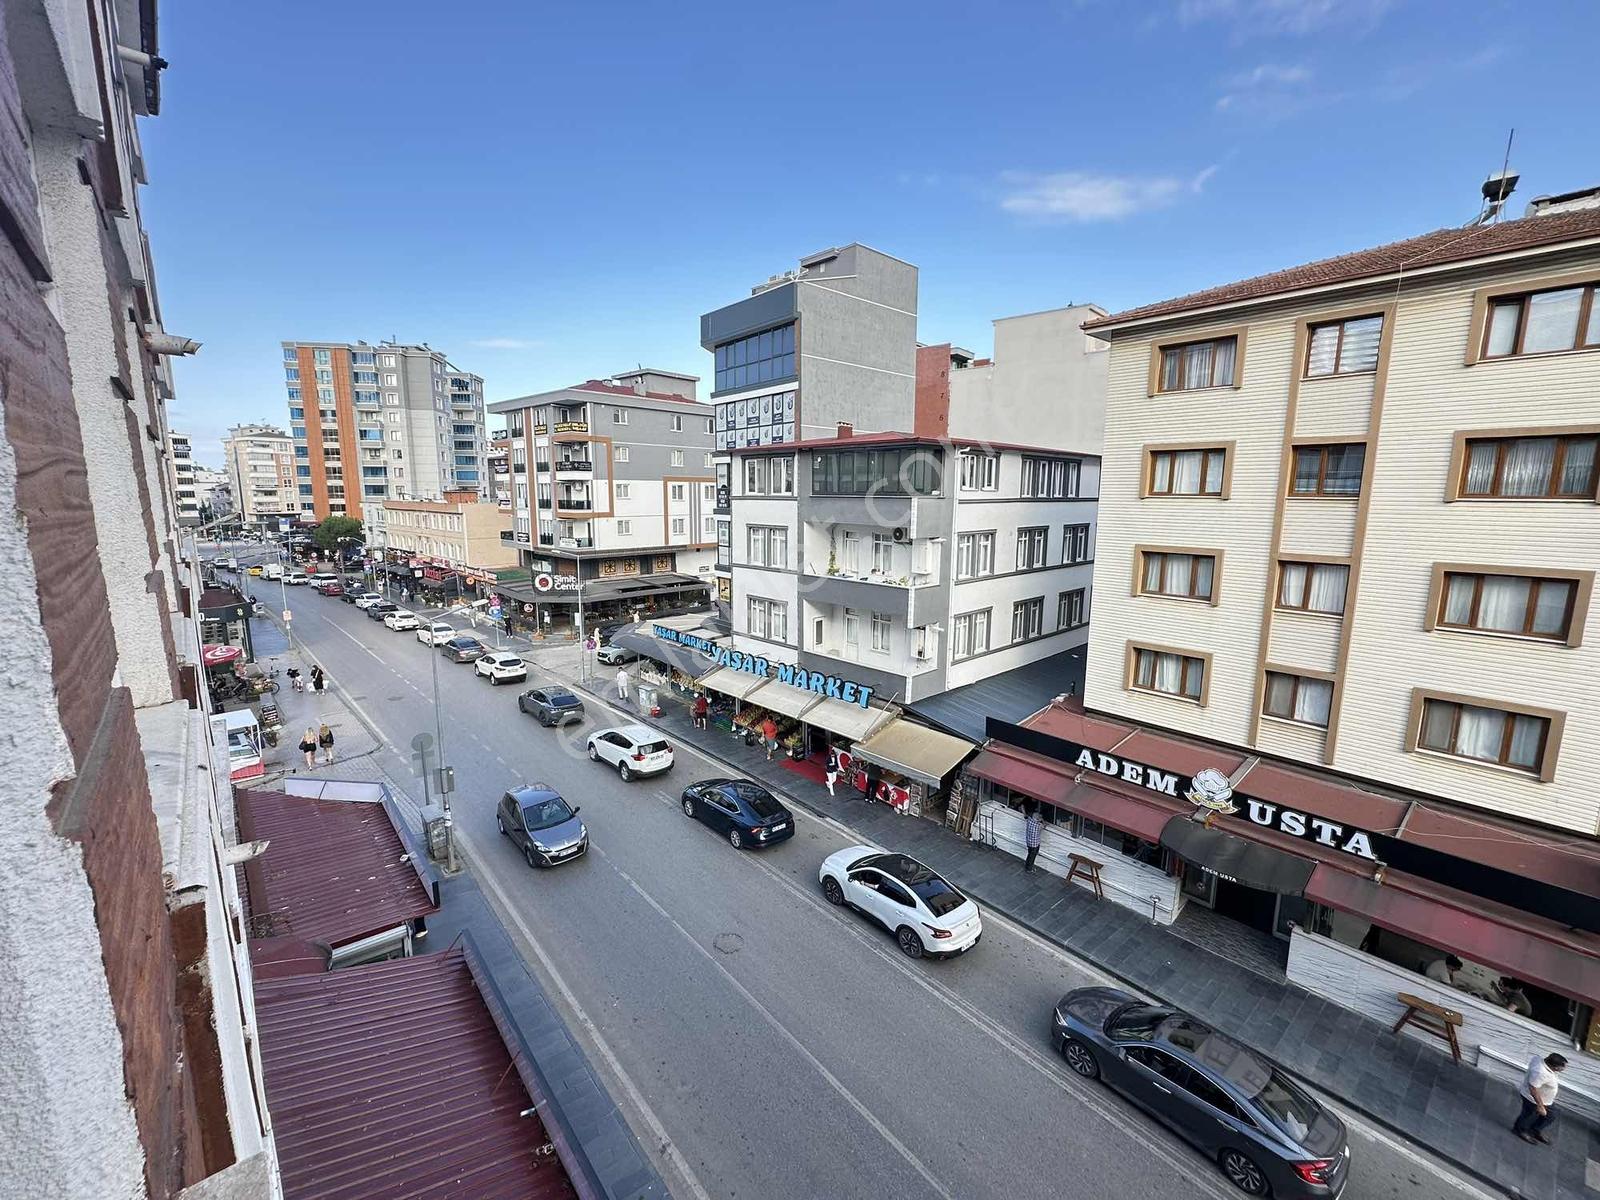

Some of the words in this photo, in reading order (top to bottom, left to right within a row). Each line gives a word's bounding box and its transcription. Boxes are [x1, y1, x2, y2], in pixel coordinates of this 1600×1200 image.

[554, 575, 576, 583] Simit
[652, 624, 678, 641] YAŞAR
[678, 633, 712, 653] MARKET
[710, 645, 770, 678] YAŞAR
[777, 662, 874, 709] MARKET
[1075, 748, 1179, 798] ADEM
[1247, 798, 1377, 860] USTA
[1201, 866, 1218, 876] ADEM
[1220, 873, 1237, 883] USTA
